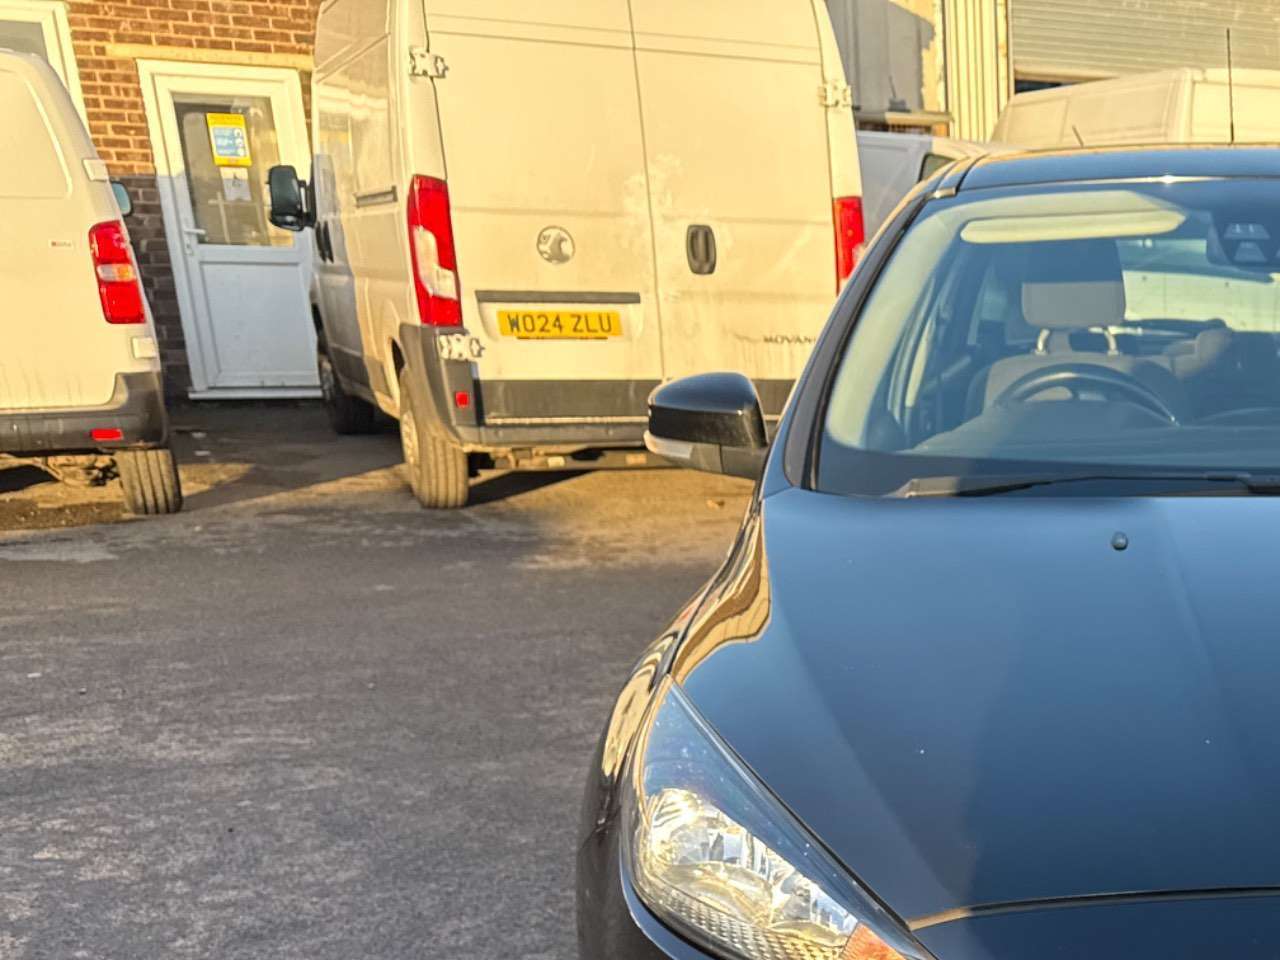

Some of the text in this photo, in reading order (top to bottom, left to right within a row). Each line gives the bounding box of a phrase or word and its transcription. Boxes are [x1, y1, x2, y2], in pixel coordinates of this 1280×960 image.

[507, 313, 613, 333] WO24 ZLU
[763, 335, 817, 344] MOVAN
